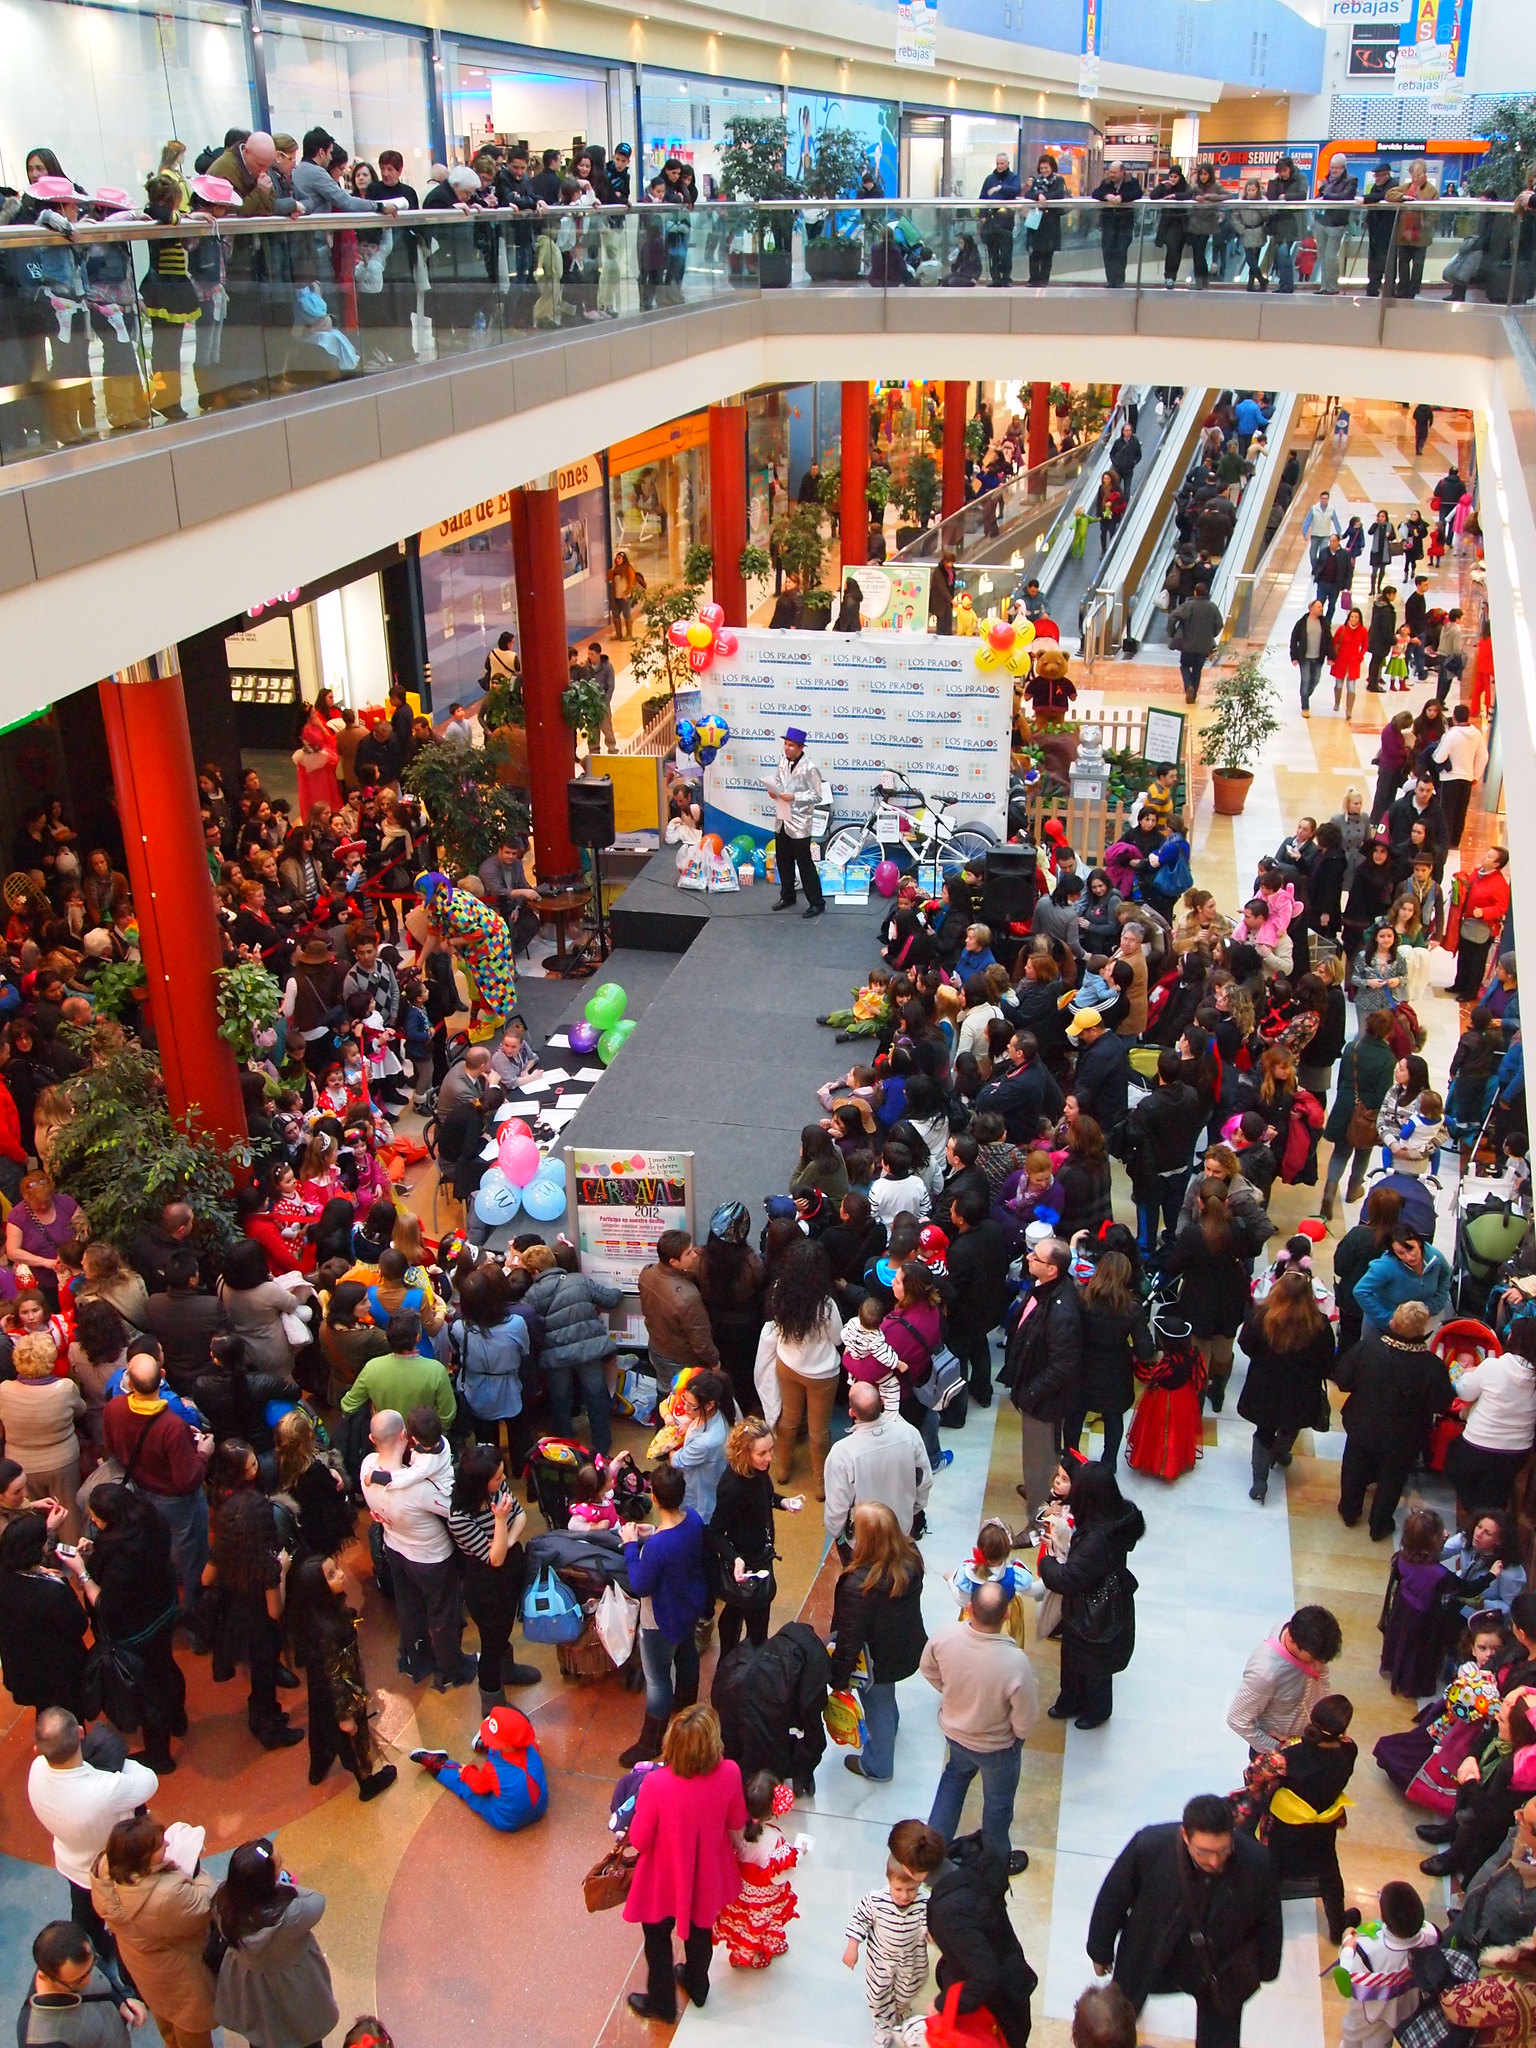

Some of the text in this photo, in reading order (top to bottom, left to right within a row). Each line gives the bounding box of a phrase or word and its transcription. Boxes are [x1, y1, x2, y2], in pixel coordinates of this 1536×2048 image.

[1333, 1, 1398, 16] rebajas
[898, 46, 930, 60] rebajas
[1398, 81, 1439, 92] rebajas
[1430, 102, 1458, 112] rebajas
[1377, 142, 1426, 150] Servicio Saturn
[1248, 152, 1284, 164] SERVICE
[476, 499, 494, 522] de
[759, 651, 812, 661] LOS PRADOS
[833, 654, 886, 664] LOS PRADOS
[928, 659, 962, 668] PRADOS
[722, 674, 774, 684] LOS PRADOS
[815, 678, 849, 687] PRADOS
[871, 681, 924, 691] LOS PRADOS
[966, 685, 1000, 694] PRADOS
[778, 703, 812, 712] PRADOS
[833, 706, 886, 716] LOS PRADOS
[927, 711, 962, 719] PRADOS
[729, 727, 775, 736] OS PRADOS
[815, 731, 849, 740] PRADOS
[889, 735, 923, 744] PRADOS
[945, 737, 998, 747] LOS PRADOS
[760, 755, 775, 763] LOS
[852, 759, 886, 767] PRADOS
[926, 763, 959, 773] PRADOS
[744, 779, 764, 787] PRAD
[962, 791, 996, 800] PRADOS
[582, 1178, 681, 1206] CARNAVAL
[635, 1206, 659, 1218] 2012
